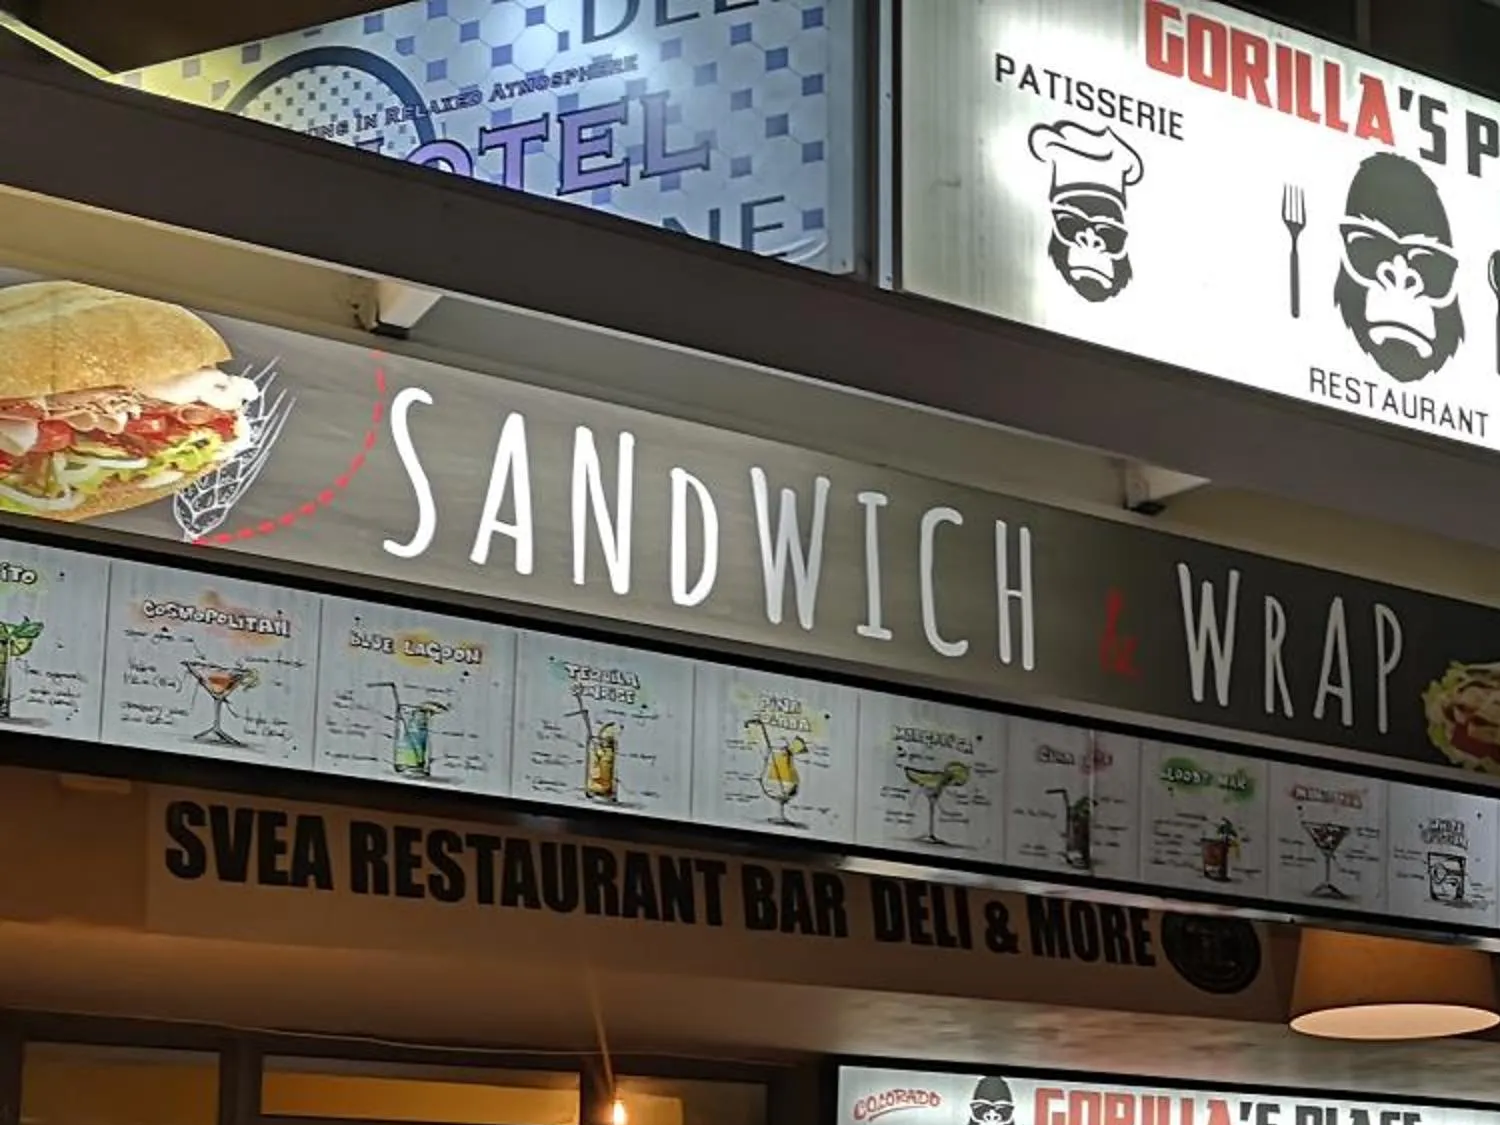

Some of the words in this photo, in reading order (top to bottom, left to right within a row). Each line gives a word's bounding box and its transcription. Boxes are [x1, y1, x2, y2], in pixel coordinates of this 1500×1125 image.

[995, 53, 1185, 141] PATISSERIE
[1145, 0, 1448, 164] GORILLA'S
[357, 90, 711, 196] OTEL
[1309, 367, 1490, 438] RESTAURANT
[384, 387, 1034, 671] SANDWICH
[1177, 562, 1402, 734] WRAP
[143, 600, 292, 638] COSMOPOLITAN
[165, 800, 334, 891] SVEA
[350, 820, 727, 927] RESTAURANT
[741, 862, 849, 938] BAR
[871, 875, 973, 950] DELI
[984, 899, 1021, 956] &
[1026, 894, 1157, 967] MORE
[853, 1088, 942, 1122] COLORADO
